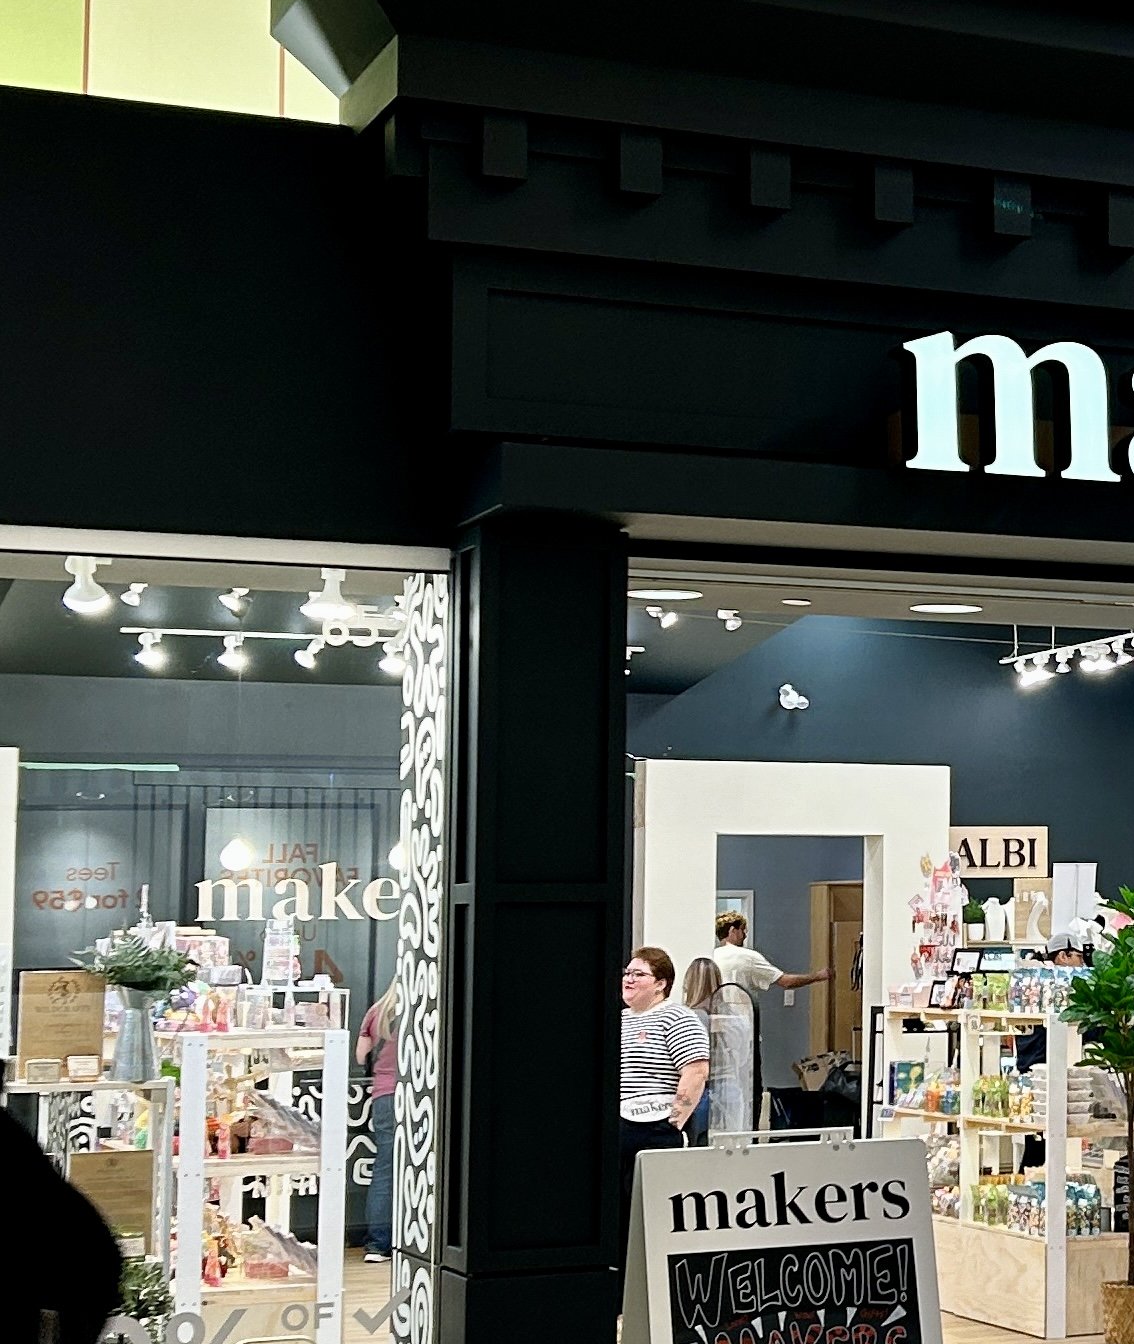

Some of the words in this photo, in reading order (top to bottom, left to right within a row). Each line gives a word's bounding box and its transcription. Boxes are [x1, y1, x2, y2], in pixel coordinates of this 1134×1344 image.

[958, 837, 1037, 868] ALBI
[668, 1171, 911, 1234] makers
[281, 1302, 335, 1331] OF
